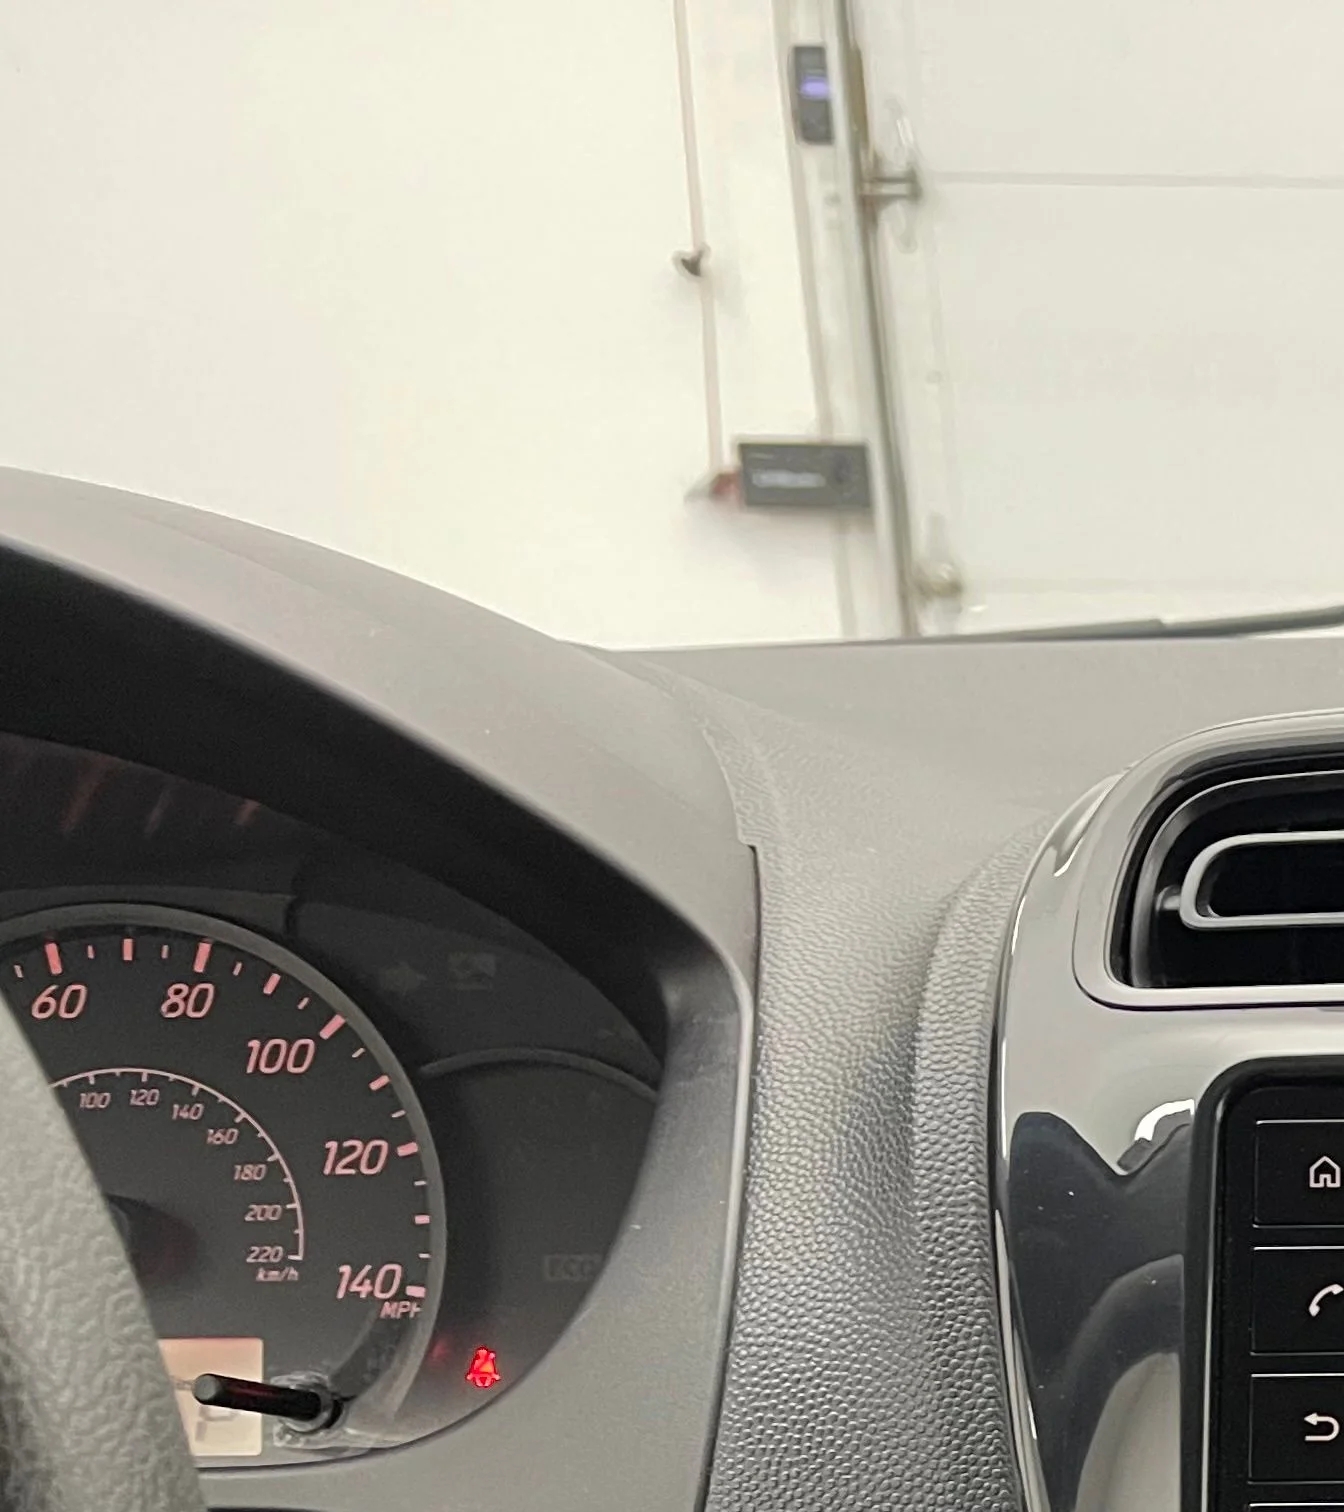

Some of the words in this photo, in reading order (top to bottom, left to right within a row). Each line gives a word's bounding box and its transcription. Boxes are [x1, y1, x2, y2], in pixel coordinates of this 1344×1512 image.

[31, 984, 88, 1019] 60
[160, 983, 215, 1018] 80
[246, 1038, 316, 1074] 100
[79, 1091, 111, 1110] 100
[129, 1088, 160, 1107] 120
[171, 1103, 204, 1121] 140
[206, 1127, 239, 1145] 160
[323, 1139, 389, 1176] 120
[233, 1163, 267, 1181] 180
[244, 1204, 282, 1222] 200
[246, 1246, 284, 1263] 220
[255, 1267, 299, 1282] km/h
[336, 1263, 402, 1300] 140
